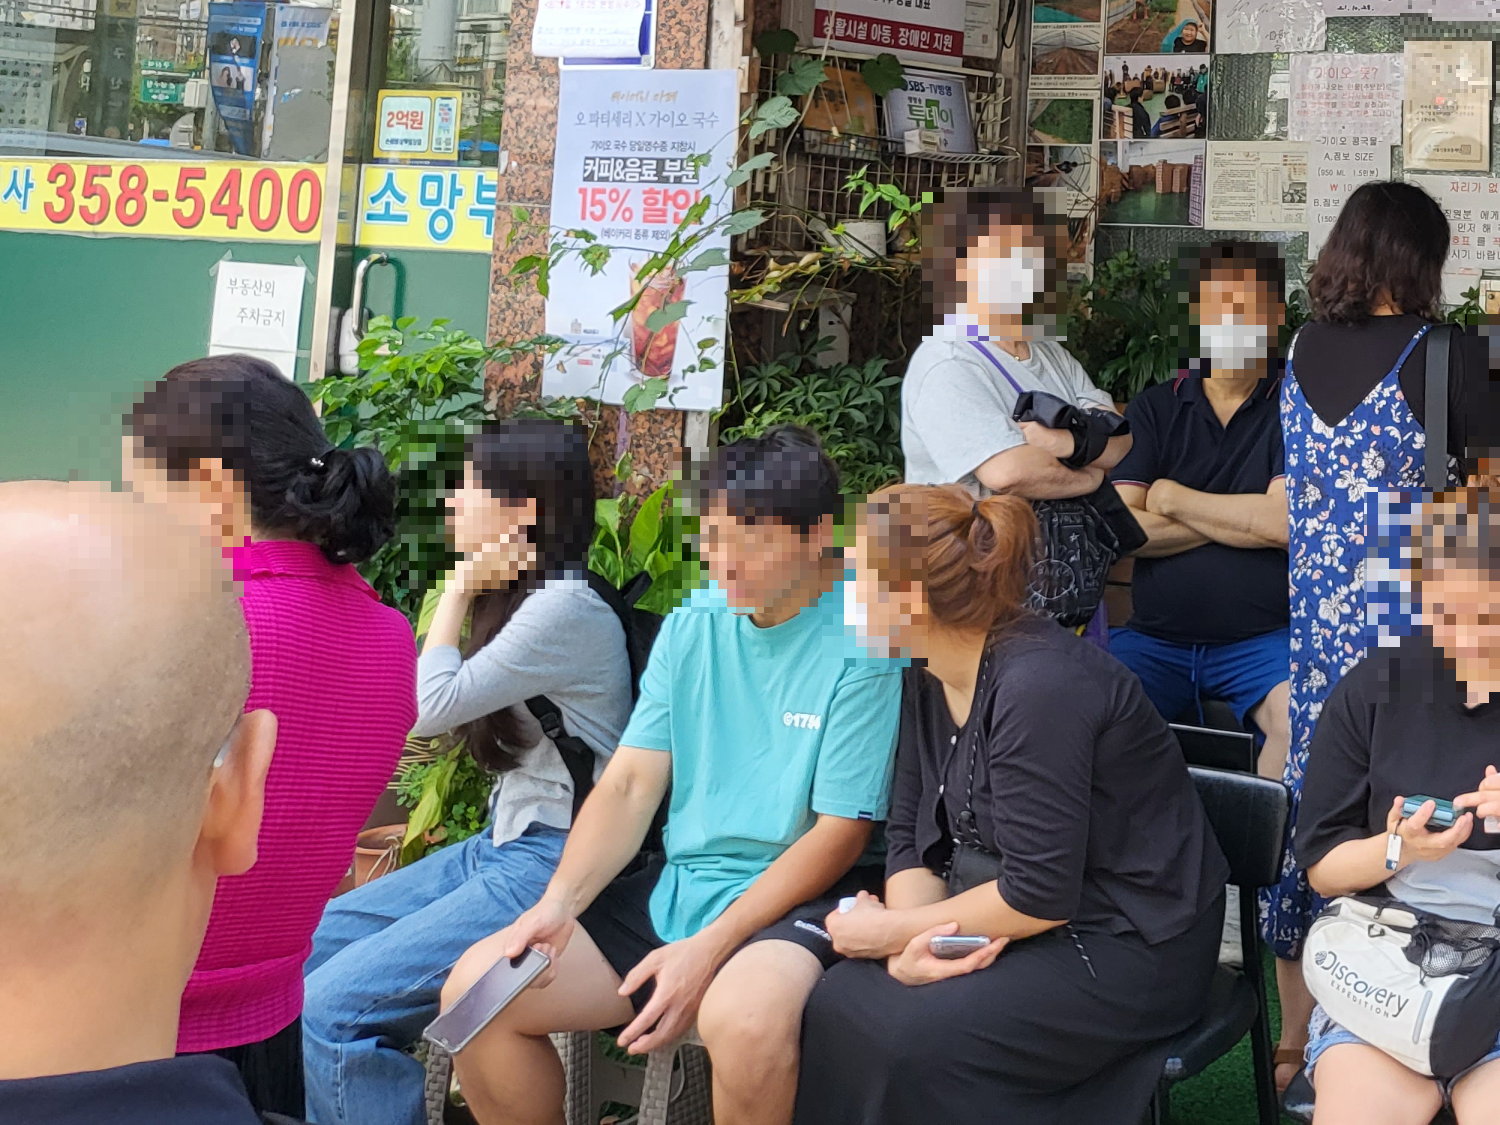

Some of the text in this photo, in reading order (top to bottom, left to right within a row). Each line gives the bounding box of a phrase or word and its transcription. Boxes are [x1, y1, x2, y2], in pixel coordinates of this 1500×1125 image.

[898, 27, 931, 49] 장애인
[933, 32, 954, 53] 지원
[386, 110, 425, 131] 2억원
[574, 111, 587, 126] 오
[589, 110, 633, 128] 파티세리
[650, 110, 690, 129] 가이오
[691, 111, 720, 129] 국수
[590, 140, 613, 152] 가이오
[613, 140, 628, 151] 국수
[671, 140, 697, 153] 지참시
[1354, 152, 1375, 162] SIZE
[583, 157, 659, 182] 커피&음료
[1450, 181, 1482, 193] 자리가
[43, 162, 323, 234] 358-5400
[577, 186, 702, 225] 15% 할인
[1480, 210, 1499, 221] 에게
[1482, 223, 1491, 233] 해
[226, 277, 276, 298] 부동산외
[236, 307, 286, 328] 주차금지
[1330, 979, 1390, 1019] EXPEDITION
